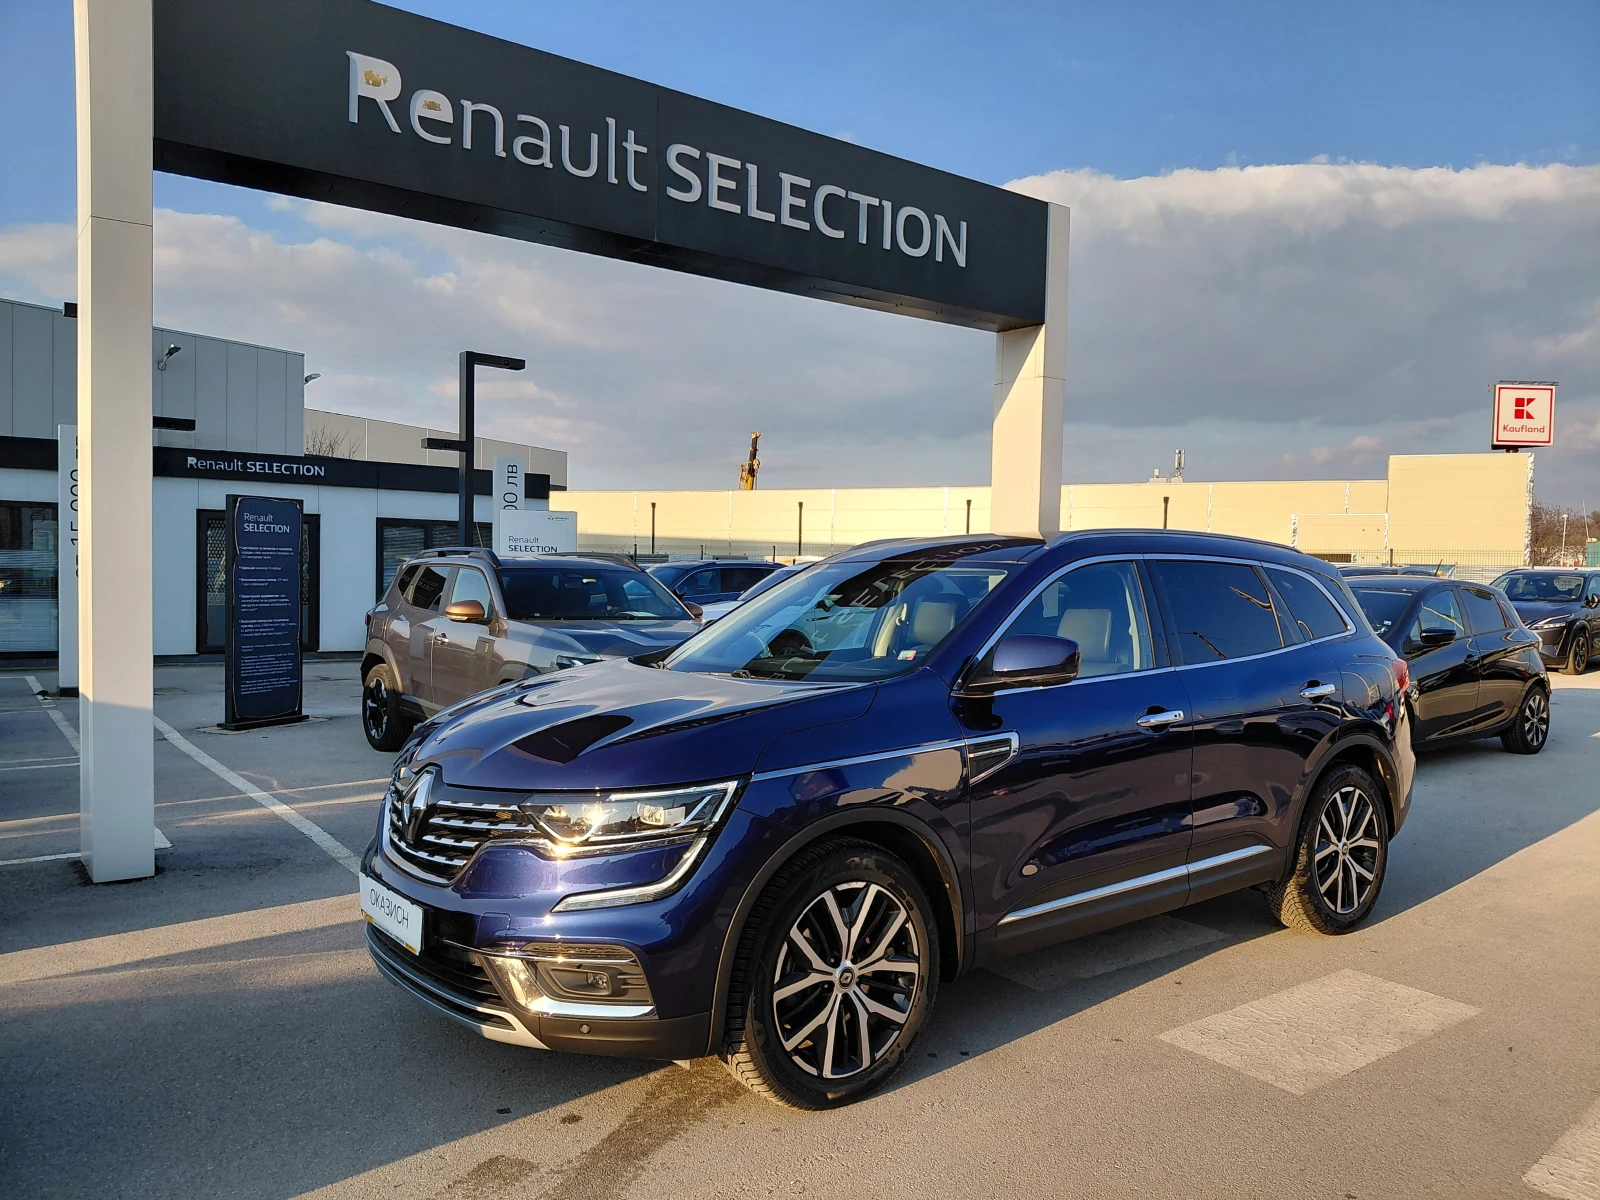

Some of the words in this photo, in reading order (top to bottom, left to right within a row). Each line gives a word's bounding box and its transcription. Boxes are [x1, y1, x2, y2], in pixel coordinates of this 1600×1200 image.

[345, 49, 649, 193] Renault
[665, 142, 969, 269] SELECTION
[1503, 424, 1545, 433] Kaufland
[187, 456, 244, 472] Renault
[246, 461, 325, 477] SELECTION
[243, 512, 274, 523] Renault
[243, 523, 290, 533] SELECTION
[508, 535, 540, 544] Renault
[508, 544, 558, 553] SELECTION
[369, 888, 409, 929] ОКАЗИОН
